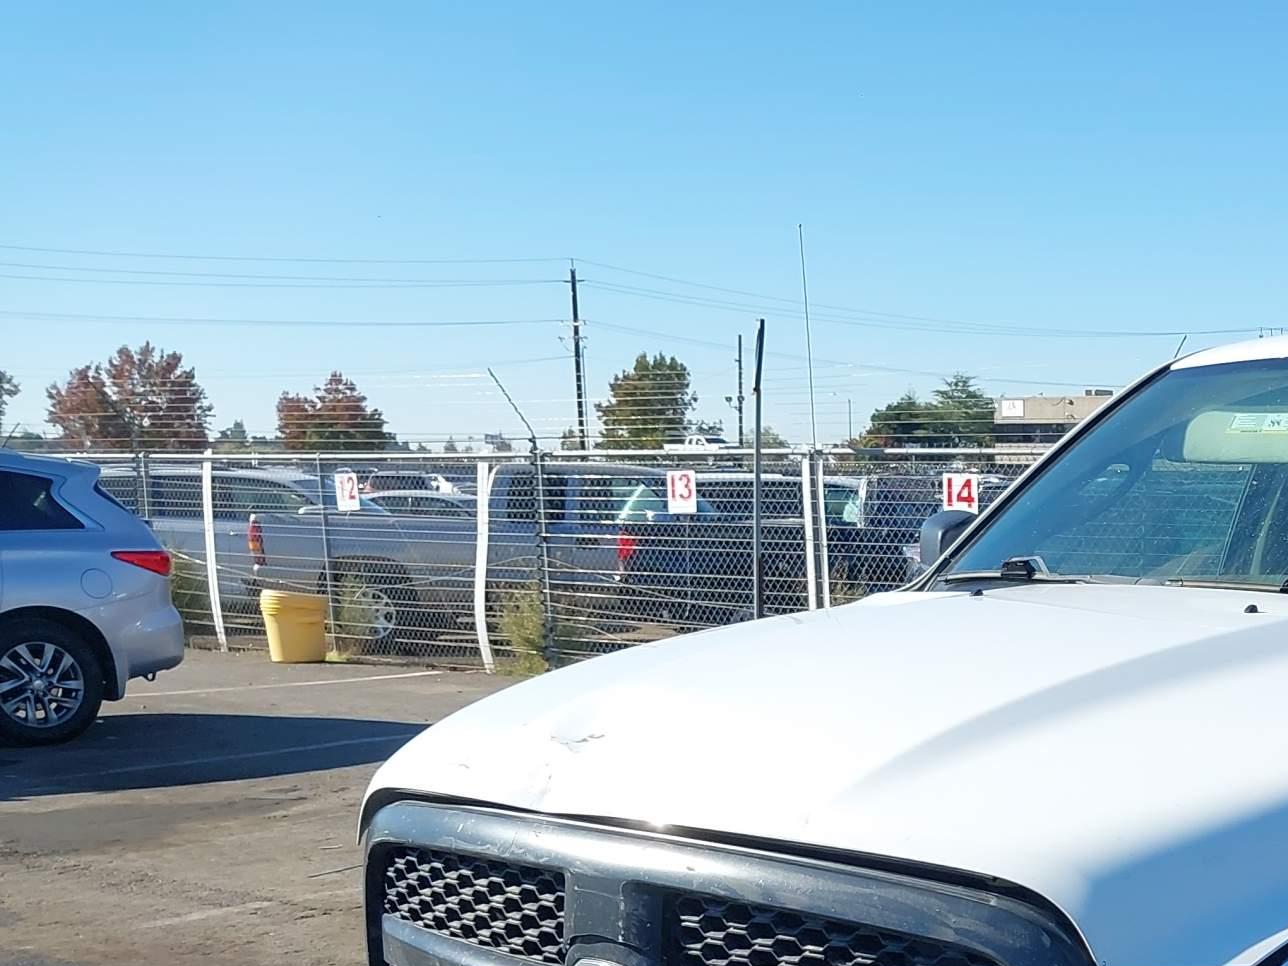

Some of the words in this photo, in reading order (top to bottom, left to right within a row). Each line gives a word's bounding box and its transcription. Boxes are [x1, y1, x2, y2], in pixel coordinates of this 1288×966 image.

[340, 476, 357, 500] 12
[671, 474, 692, 499] 13
[947, 477, 975, 508] 14
